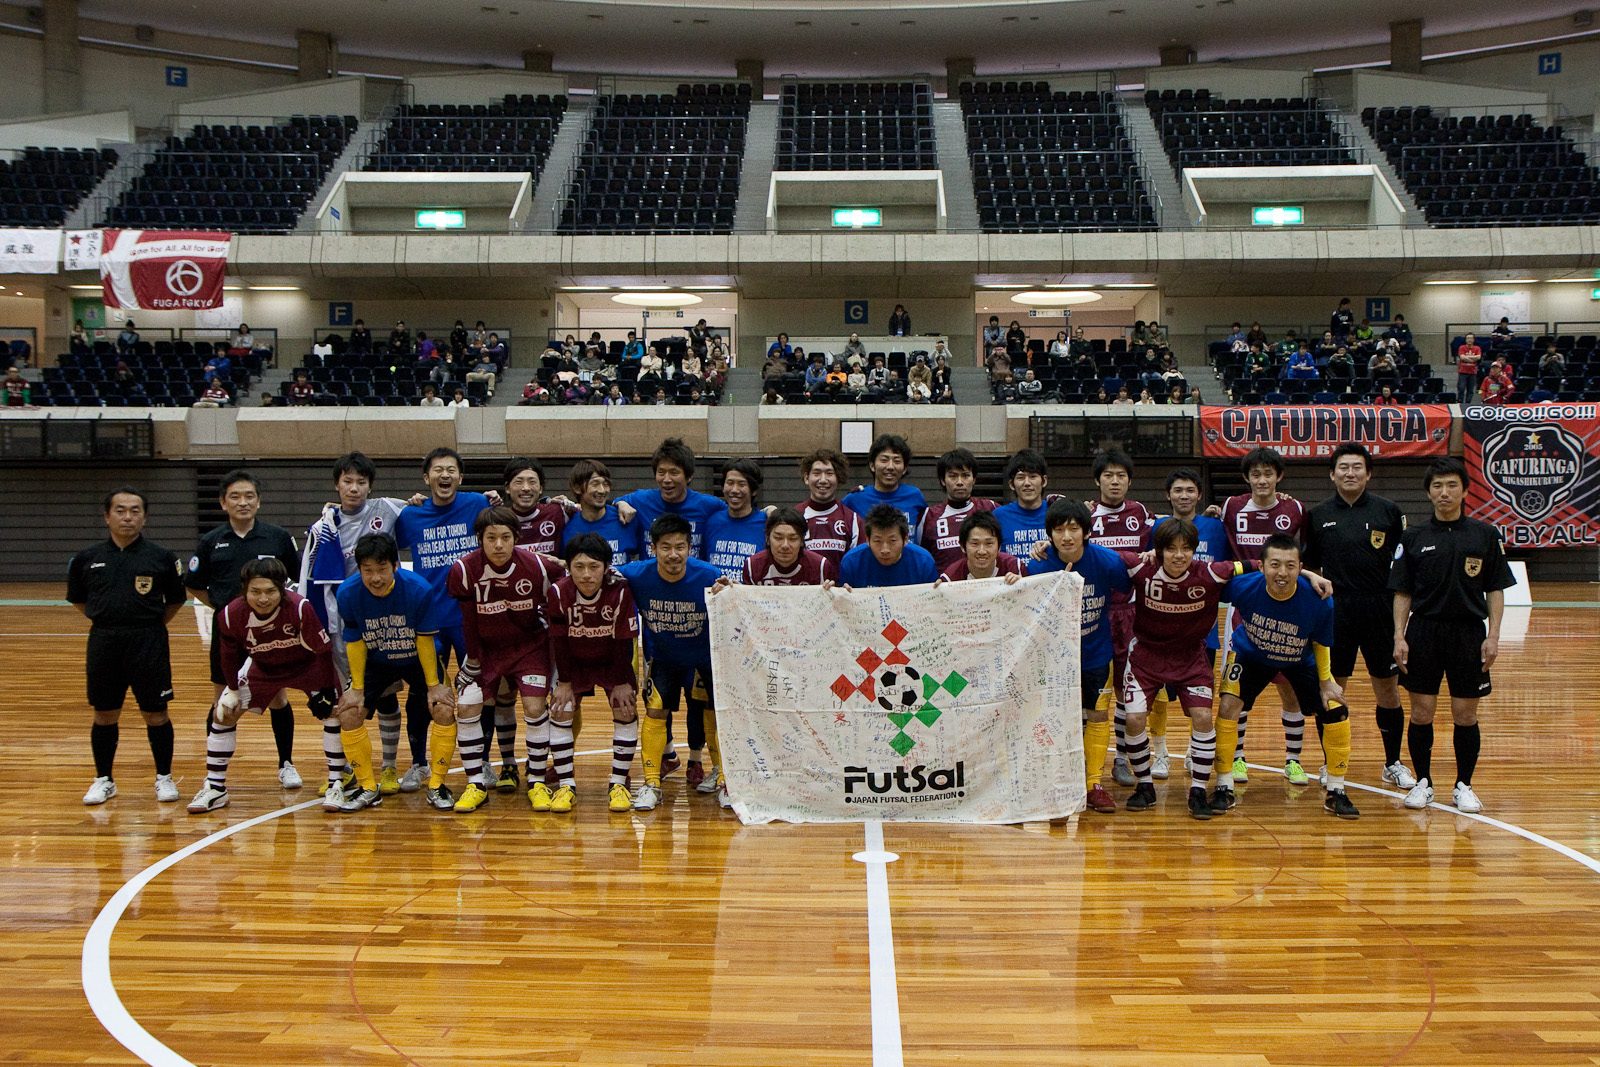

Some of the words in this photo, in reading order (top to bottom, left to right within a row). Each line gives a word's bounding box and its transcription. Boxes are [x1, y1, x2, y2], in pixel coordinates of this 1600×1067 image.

[1543, 57, 1557, 72] H
[170, 69, 183, 84] F
[153, 298, 180, 308] FUGA
[182, 298, 213, 308] TOKYO
[1371, 302, 1385, 318] H
[335, 306, 347, 321] F
[849, 304, 864, 320] G
[1220, 407, 1429, 443] CAFURINGA
[1523, 443, 1543, 451] 2005
[1490, 458, 1576, 475] CAFURINGA
[936, 518, 949, 537] 8
[1092, 516, 1105, 536] 4
[1236, 512, 1249, 532] 6
[423, 527, 436, 541] PRAY
[436, 526, 447, 539] FOR
[446, 523, 467, 538] TOHOKU
[1013, 530, 1028, 542] PRAY
[1027, 529, 1039, 541] FOR
[1514, 524, 1550, 545] BY
[1550, 523, 1597, 545] ALL
[431, 540, 446, 554] DEAR
[445, 538, 460, 552] BOYS
[715, 540, 728, 552] PRAY
[727, 540, 738, 553] FOR
[473, 580, 491, 603] 17
[1144, 577, 1163, 601] 16
[650, 599, 664, 611] PRAY
[664, 600, 675, 612] FOR
[675, 601, 696, 613] TOHOKU
[567, 605, 583, 626] 15
[1251, 612, 1266, 627] PRAY
[1265, 617, 1277, 630] FOR
[1277, 620, 1299, 636] TOHOKU
[851, 796, 879, 804] JAPAN
[880, 796, 909, 804] FUTSAL
[910, 791, 957, 803] FEDERATION
